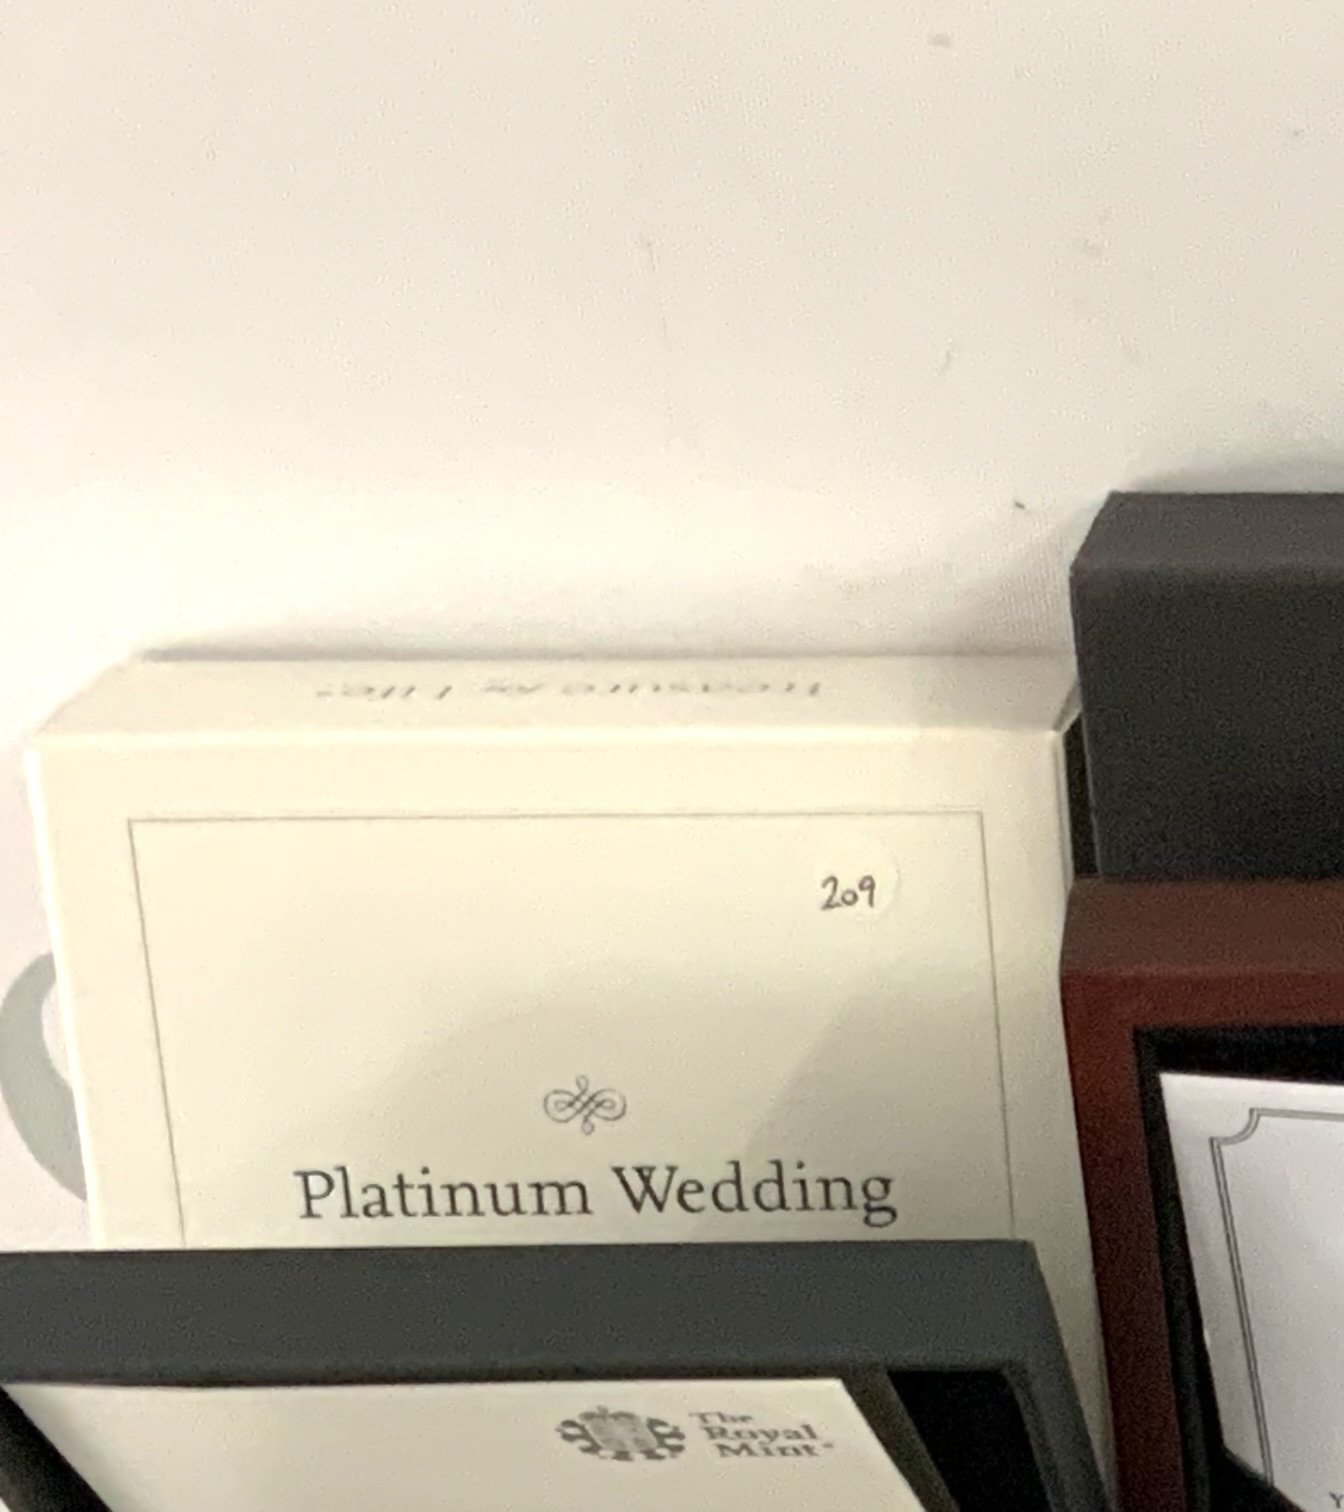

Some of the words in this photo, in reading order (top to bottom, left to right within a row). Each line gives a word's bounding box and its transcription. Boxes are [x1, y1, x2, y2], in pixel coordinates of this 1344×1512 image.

[820, 875, 875, 910] 209
[293, 1166, 594, 1220] Platinum
[612, 1159, 898, 1228] Wedding
[688, 1411, 753, 1424] The
[702, 1424, 818, 1442] Royal
[716, 1442, 818, 1457] Mint
